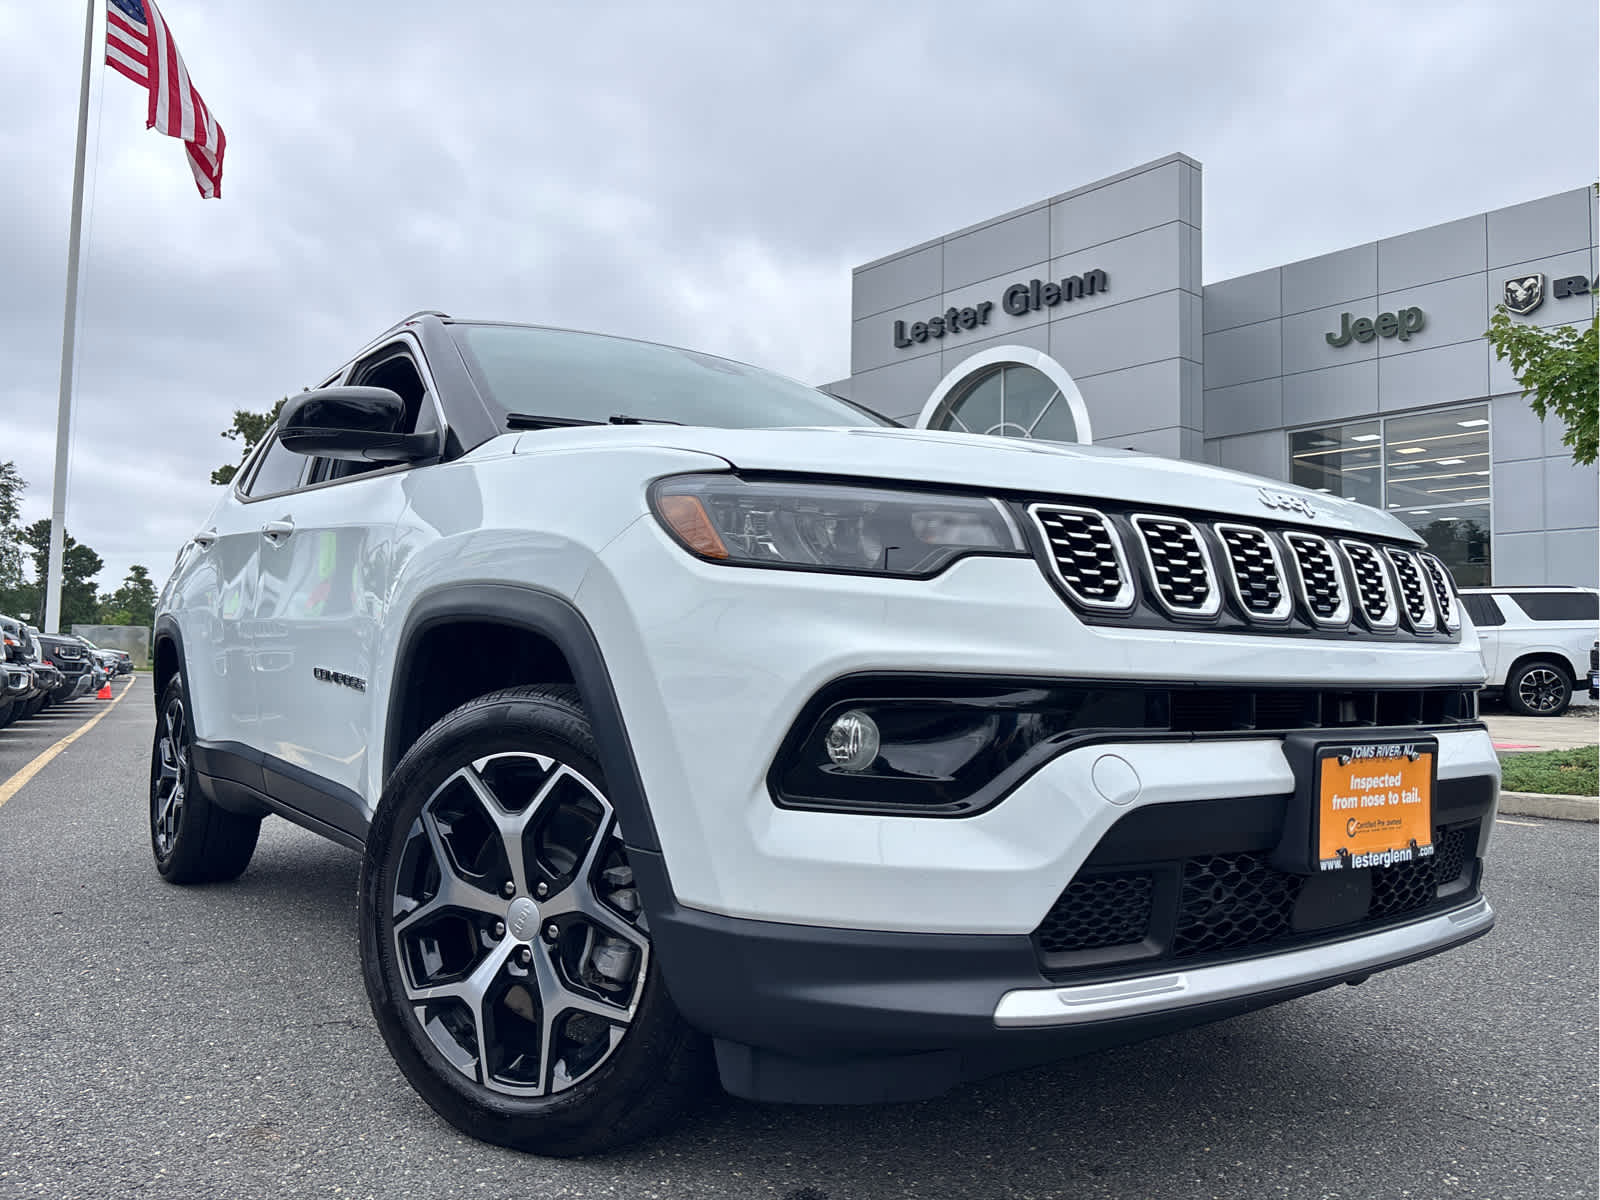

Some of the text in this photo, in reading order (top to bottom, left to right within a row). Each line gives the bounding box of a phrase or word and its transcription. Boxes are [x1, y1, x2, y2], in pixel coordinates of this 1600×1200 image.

[1553, 272, 1599, 299] R
[893, 268, 1109, 350] Lester Glenn
[1325, 306, 1426, 348] Jeep
[1258, 487, 1316, 519] Jeep
[1351, 745, 1375, 759] TOMS
[1350, 772, 1401, 792] Inspected
[1332, 786, 1421, 811] from nose to tail.
[1320, 859, 1344, 871] www.
[1351, 848, 1412, 869] lesterglenn
